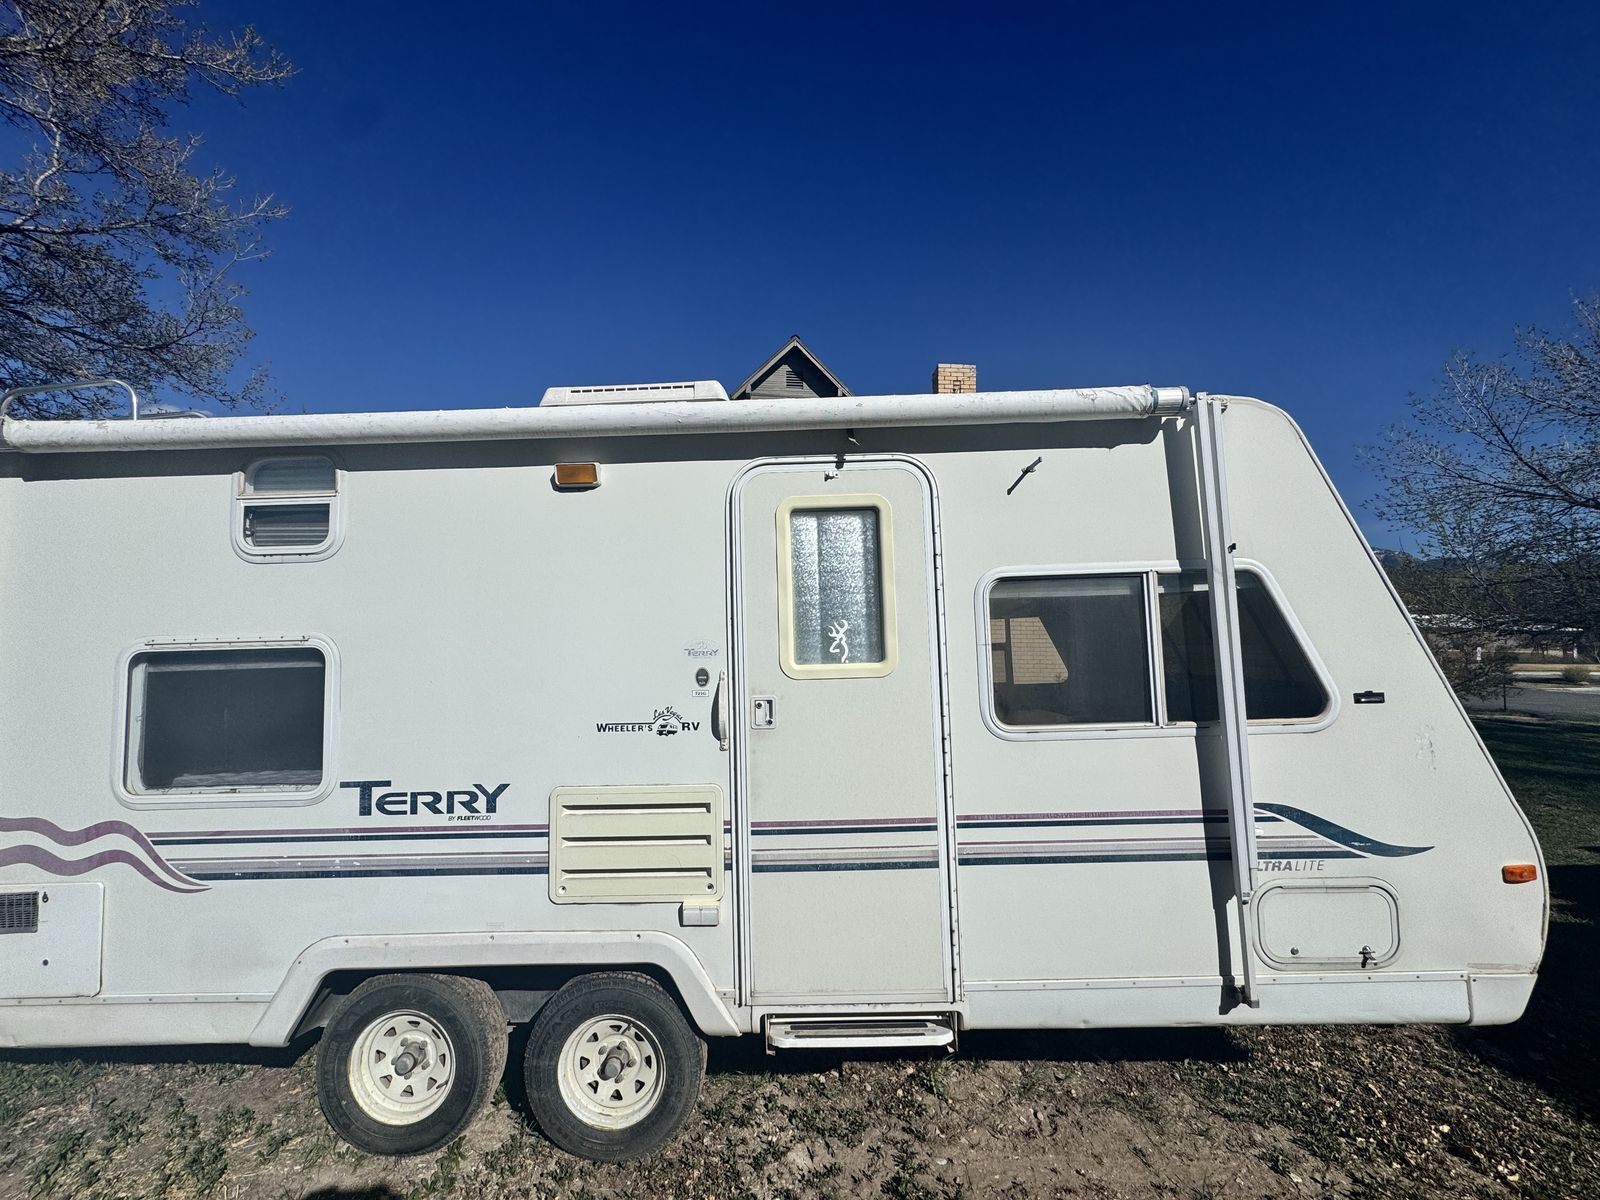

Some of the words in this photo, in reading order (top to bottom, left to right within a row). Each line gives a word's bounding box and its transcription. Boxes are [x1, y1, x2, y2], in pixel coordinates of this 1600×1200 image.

[596, 723, 653, 733] WHEELER'S
[681, 721, 700, 732] RV
[339, 780, 511, 817] TERRY
